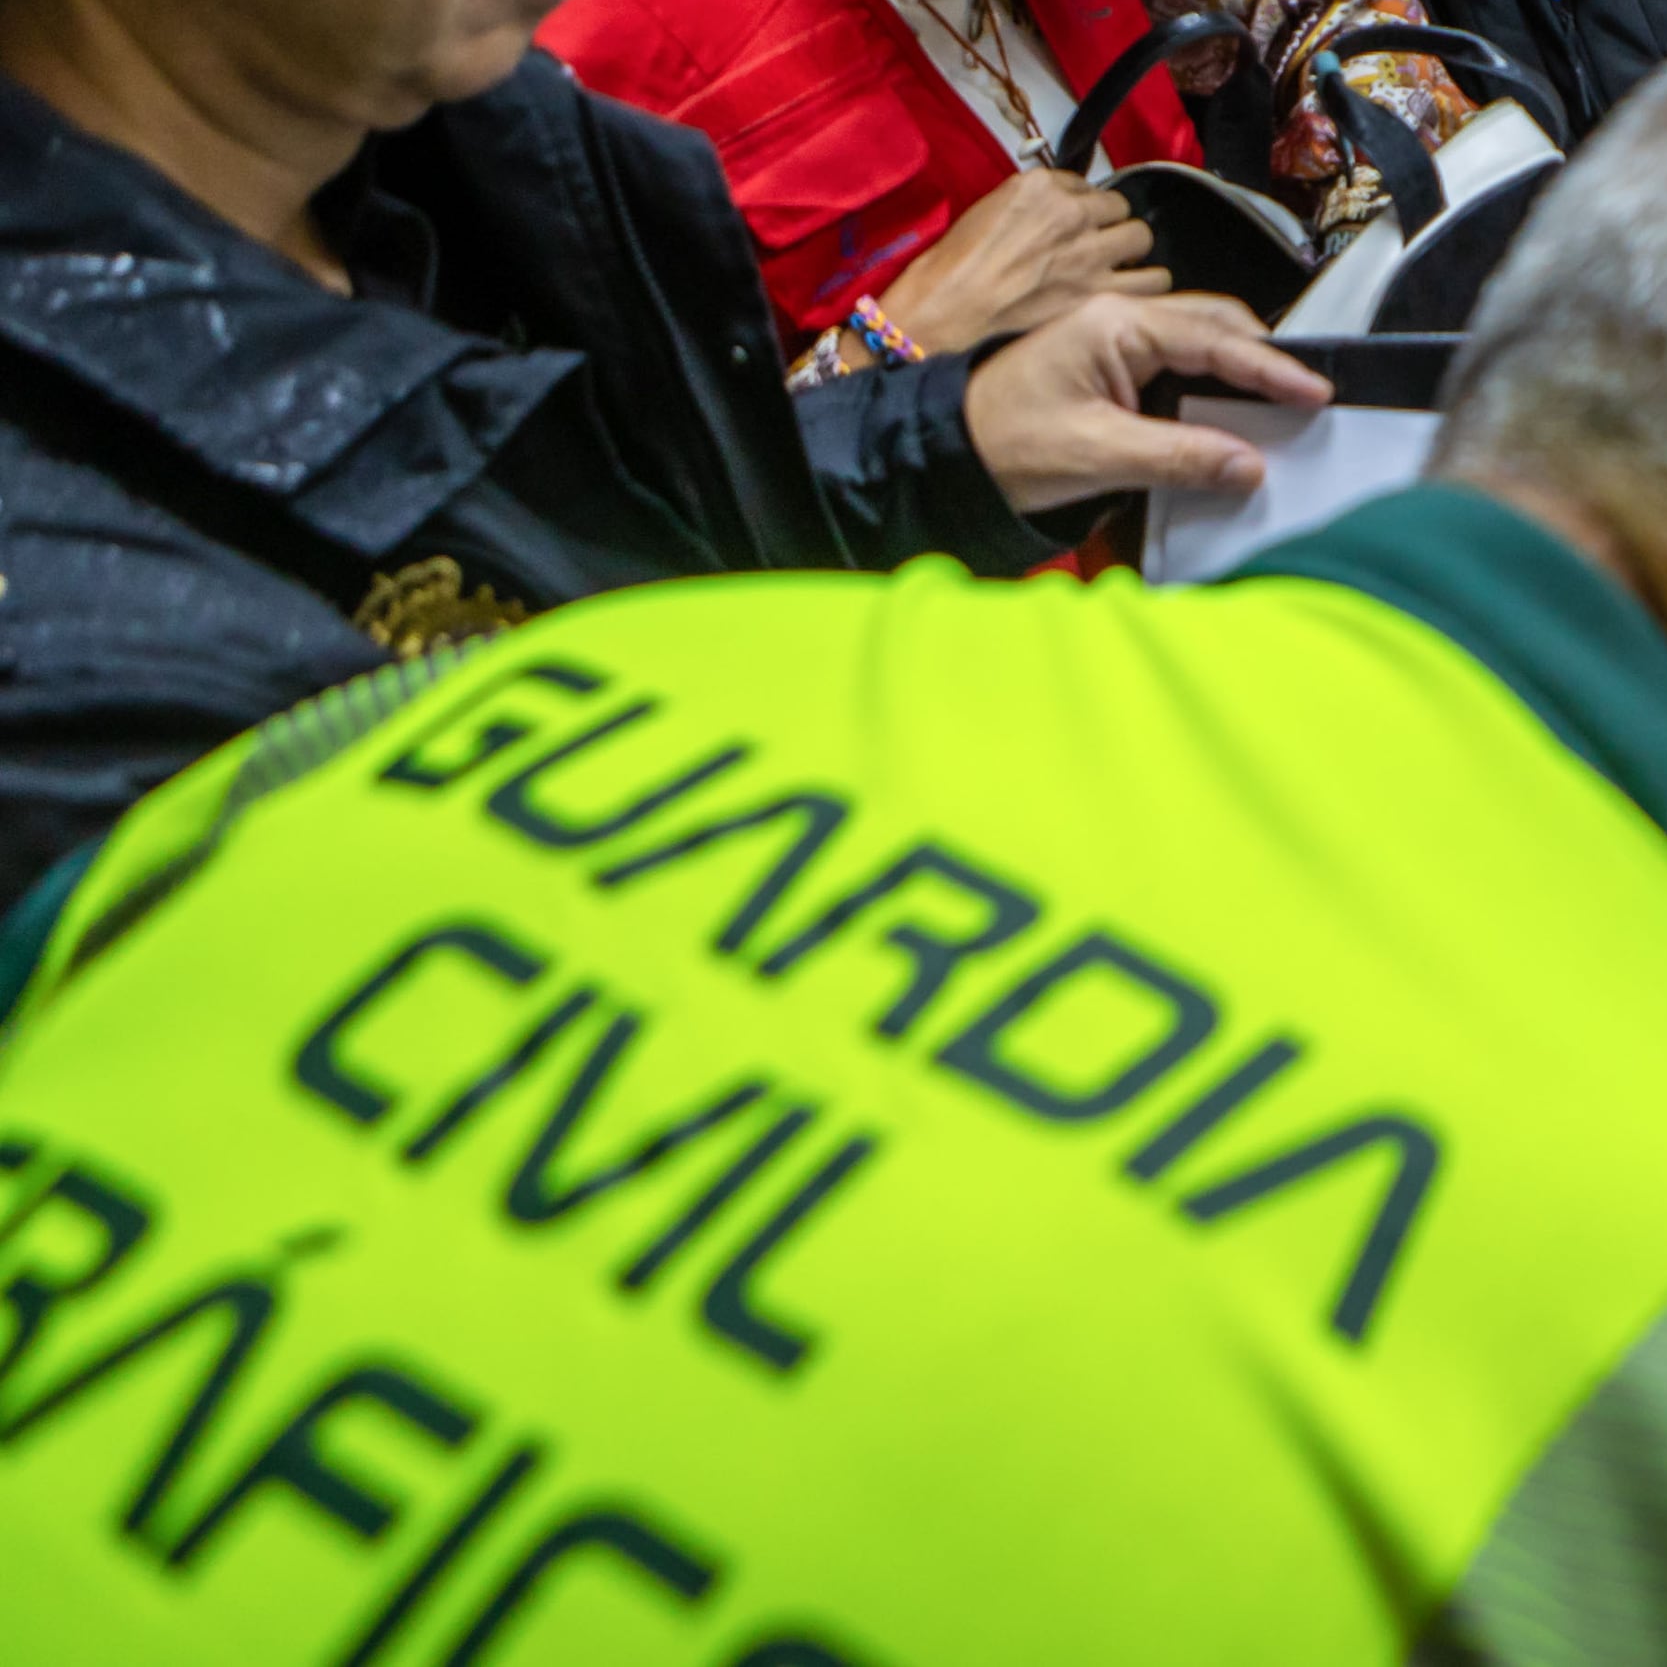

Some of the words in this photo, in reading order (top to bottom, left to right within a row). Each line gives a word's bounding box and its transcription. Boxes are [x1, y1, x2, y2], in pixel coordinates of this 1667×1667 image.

[289, 920, 882, 1373] CIVIL
[374, 656, 1446, 1345] GUARDIA
[0, 1134, 890, 1667] RÁFIC
